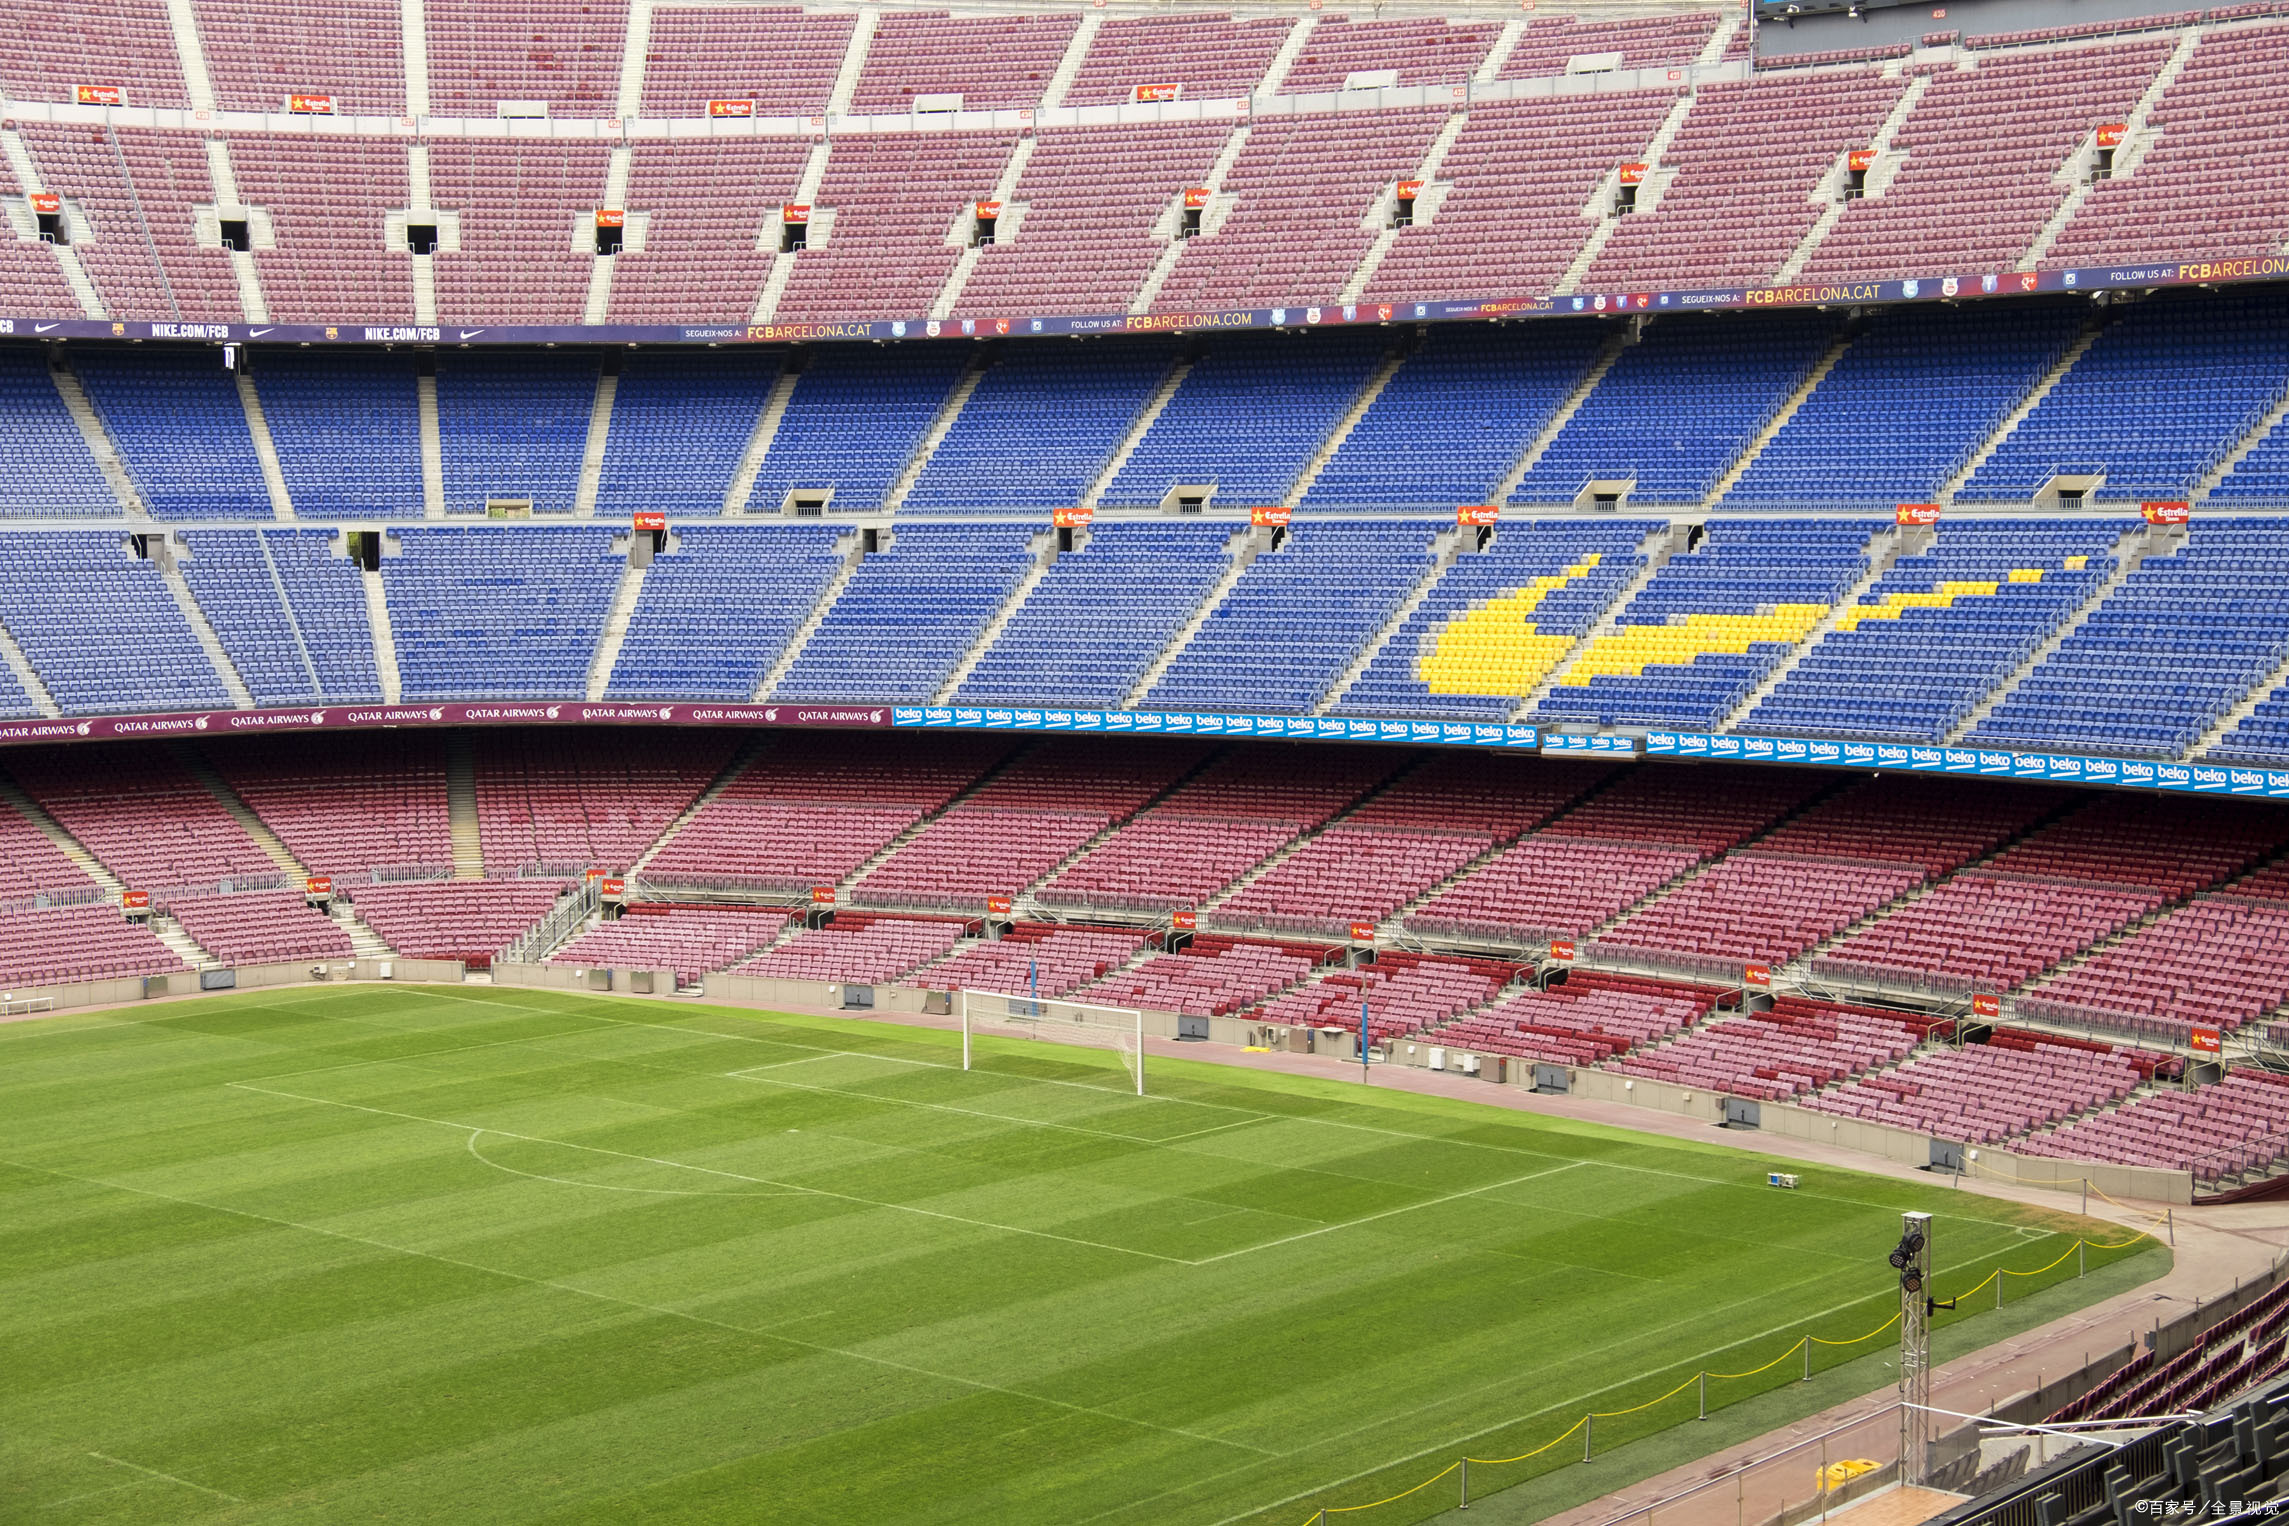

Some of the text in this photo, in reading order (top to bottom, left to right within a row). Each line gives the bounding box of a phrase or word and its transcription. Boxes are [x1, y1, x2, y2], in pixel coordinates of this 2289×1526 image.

[2111, 271, 2145, 281] FOLLOW
[2146, 270, 2158, 280] US
[2159, 269, 2174, 278] AT:
[1682, 285, 1880, 304] SEGUEIX-NOS A: FCBARCELONA.CAT
[1481, 302, 1554, 312] FCBARCELONA.CAT
[1071, 312, 1252, 328] FOLLOW US AT: FCBARCELONA.COM
[152, 324, 229, 338] NIKE.COM/FCB
[365, 328, 440, 341] NIKE.COM/FCB
[748, 324, 871, 339] FCBARCELONA.CAT
[1067, 512, 1092, 521] Estrella
[1265, 511, 1291, 520] Estrella
[1471, 510, 1498, 519] Estrella
[1911, 508, 1940, 518] Estrella
[2157, 507, 2188, 517] Estrella
[348, 710, 427, 722] QATAR AIRWAYS
[466, 708, 544, 719] QATAR AIRWAYS
[582, 709, 657, 719] QATAR AIRWAYS
[693, 710, 763, 720] QATAR AIRWAYS
[799, 711, 868, 721] QATAR AIRWAYS
[232, 714, 309, 726] QATAR AIRWAYS
[896, 708, 1535, 738] beko beko beko beko beko beko beko beko beko beko beko beko beko beko beko beko beko beko beko beko beko
[0, 726, 75, 738] ATAR AIRWAYS
[115, 720, 193, 733] QATAR AIRWAYS
[1647, 733, 1675, 745] beko
[1679, 735, 1707, 747] beko
[1711, 737, 1739, 749] beko
[1745, 739, 1773, 751] beko
[1777, 740, 1806, 753] beko
[1810, 742, 1839, 755] beko
[1845, 744, 1874, 757] beko
[1878, 746, 1908, 759] beko
[1912, 748, 1941, 761] beko
[1946, 750, 1976, 763] beko
[1980, 752, 2010, 766] beko
[2050, 757, 2081, 771] beko
[2086, 759, 2117, 773] beko
[2123, 762, 2153, 776] beko
[2158, 765, 2189, 780] beko
[2194, 768, 2226, 782] beko
[2231, 770, 2264, 785] beko
